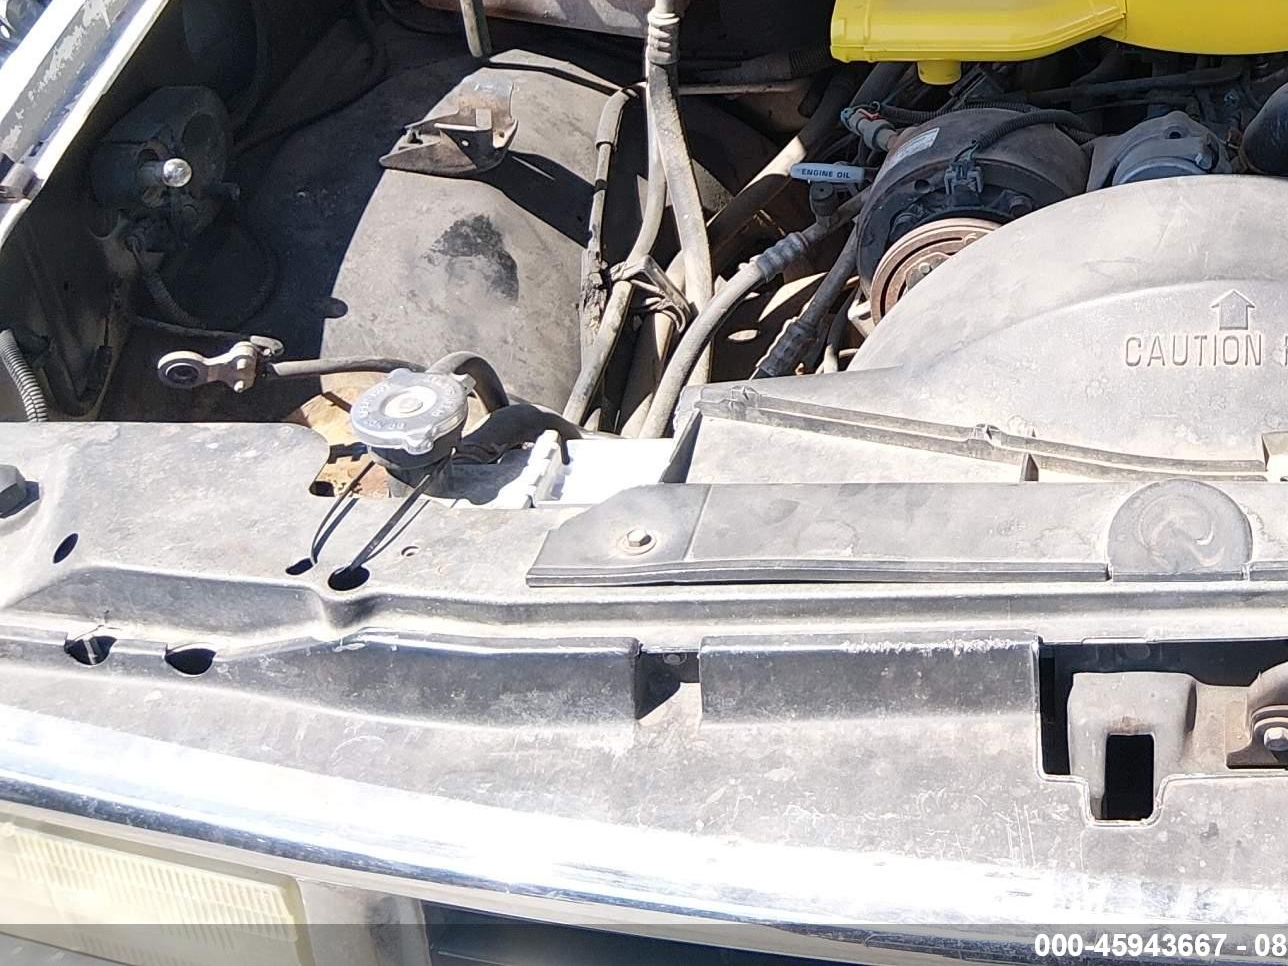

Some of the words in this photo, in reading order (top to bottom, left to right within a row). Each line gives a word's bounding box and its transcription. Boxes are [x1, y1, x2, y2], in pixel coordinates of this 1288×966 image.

[801, 168, 834, 178] ENGINE
[836, 169, 851, 179] OIL
[1125, 334, 1263, 367] CAUTION
